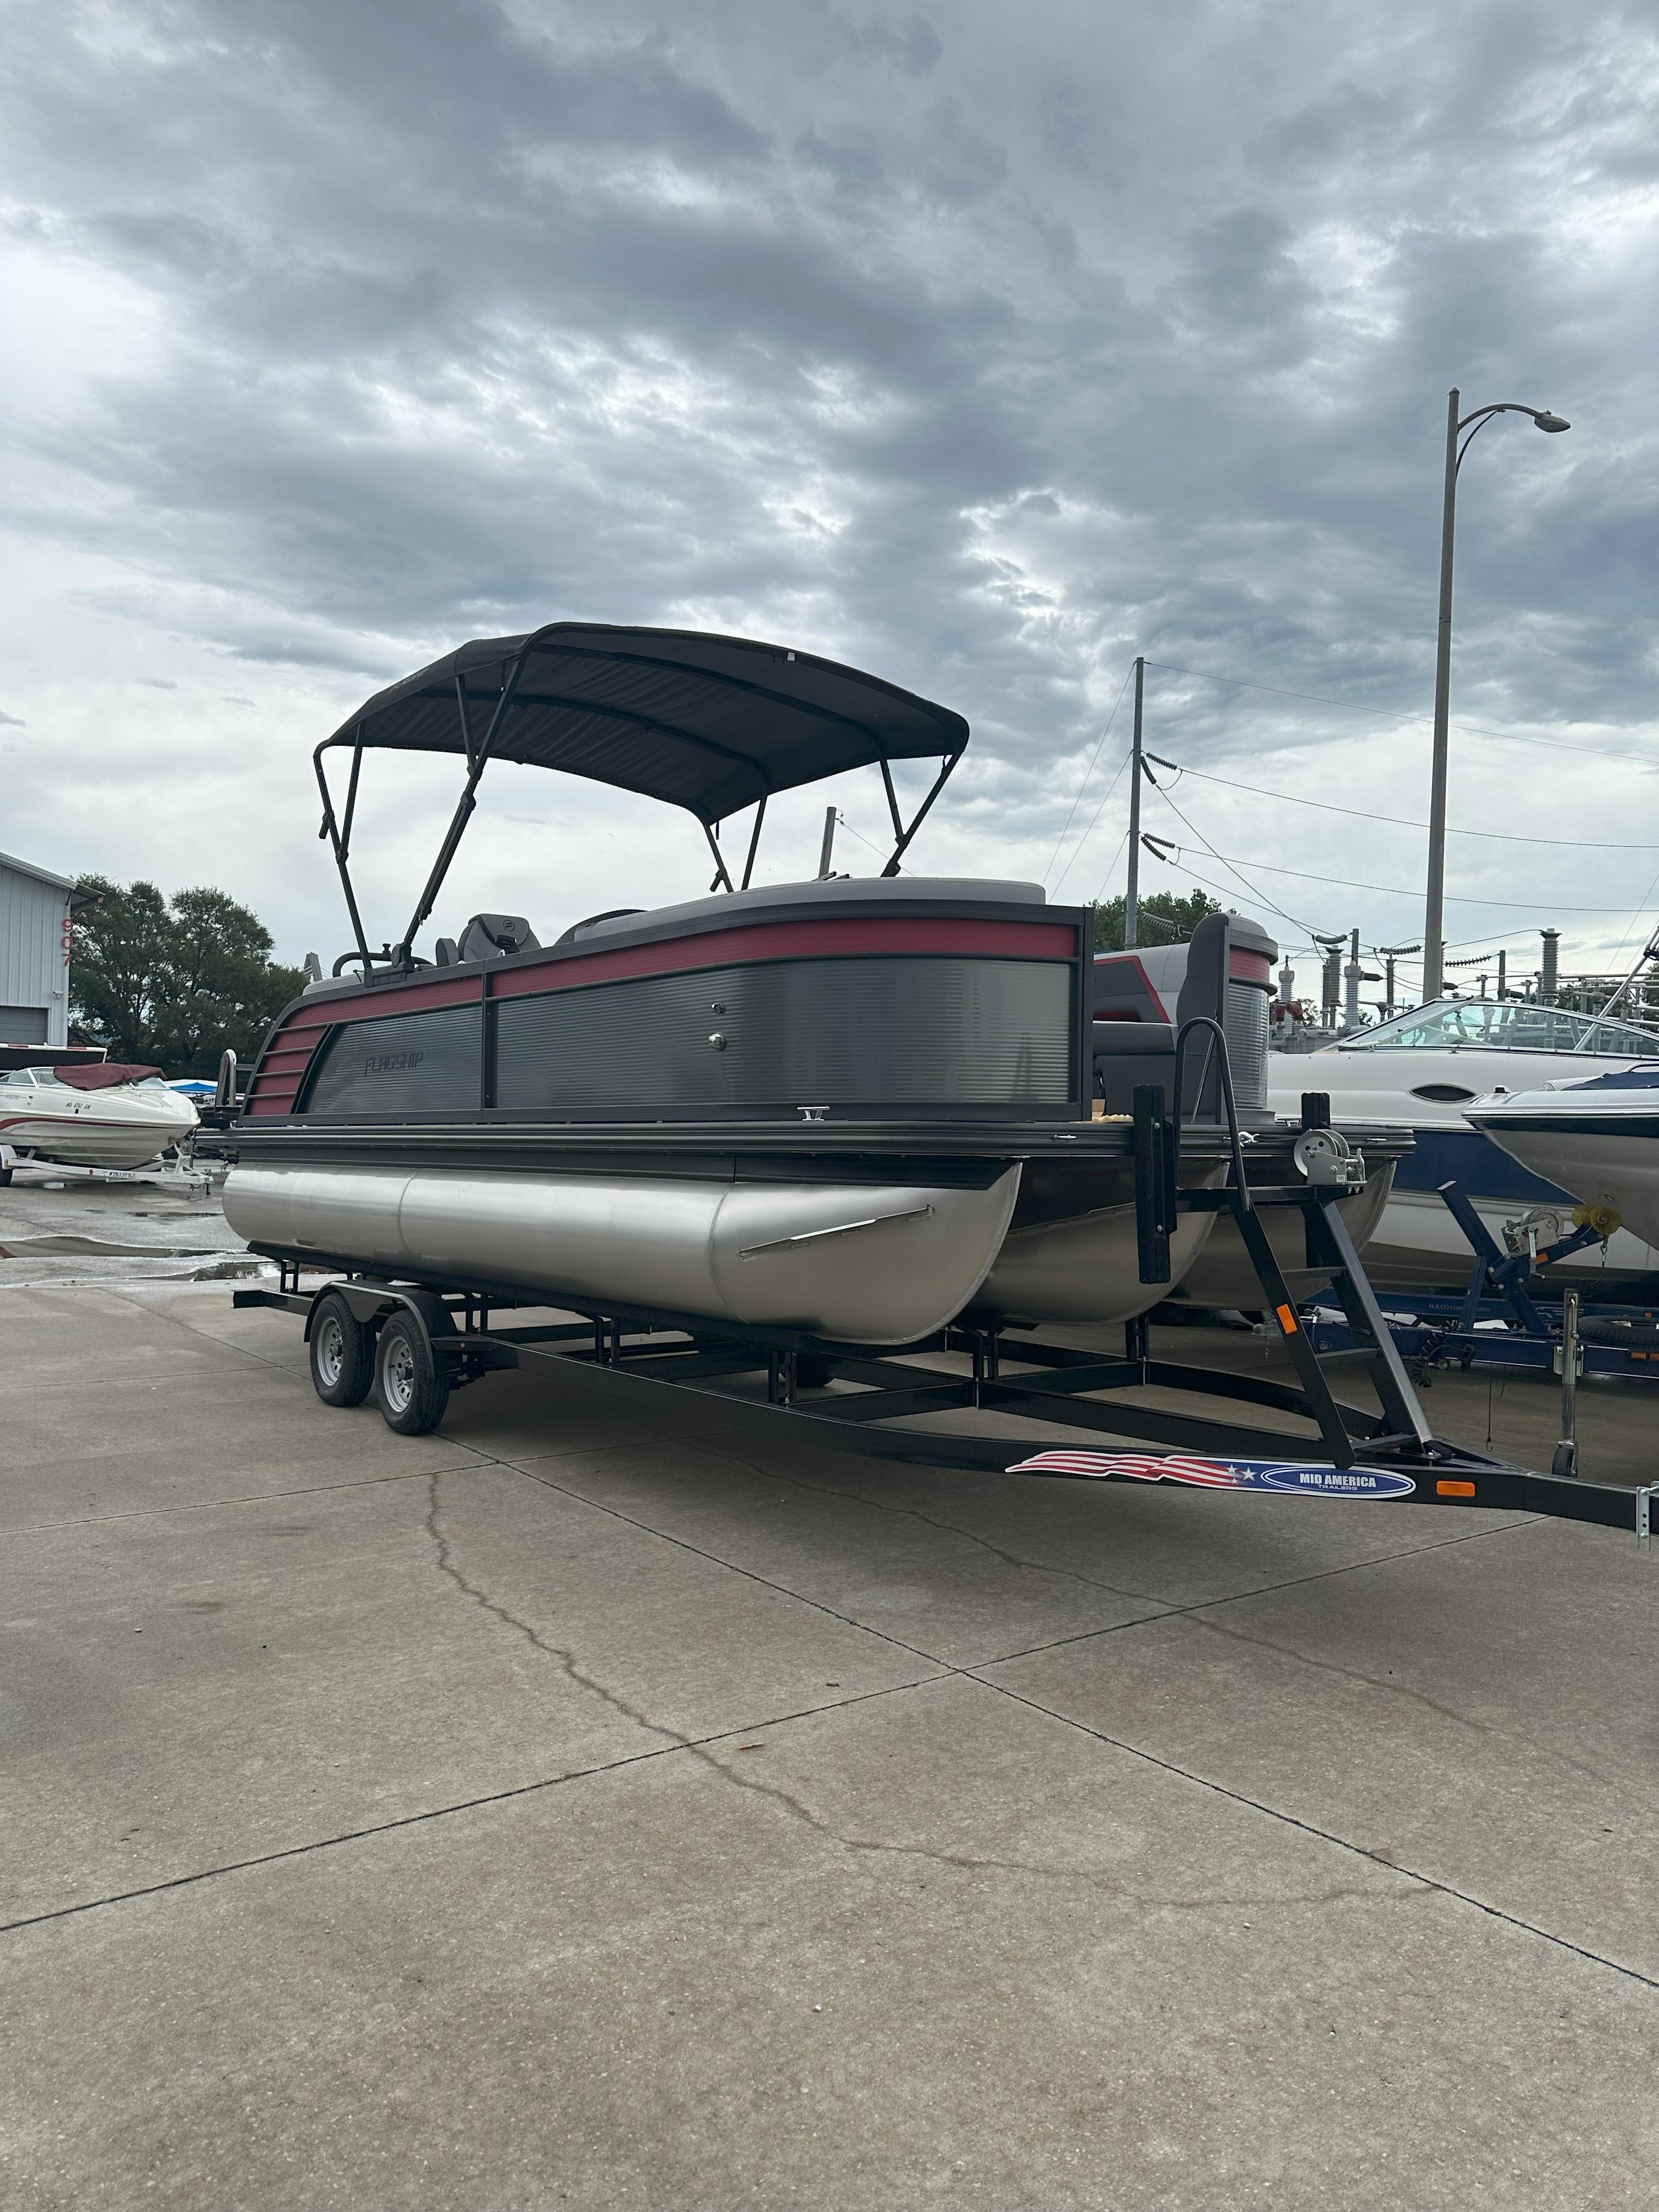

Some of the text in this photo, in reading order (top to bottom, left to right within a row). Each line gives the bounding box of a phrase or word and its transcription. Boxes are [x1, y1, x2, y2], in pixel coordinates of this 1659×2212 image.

[61, 918, 74, 966] 907
[364, 1052, 424, 1077] FLAGSHIP
[1300, 1473, 1376, 1488] MID AMERICA
